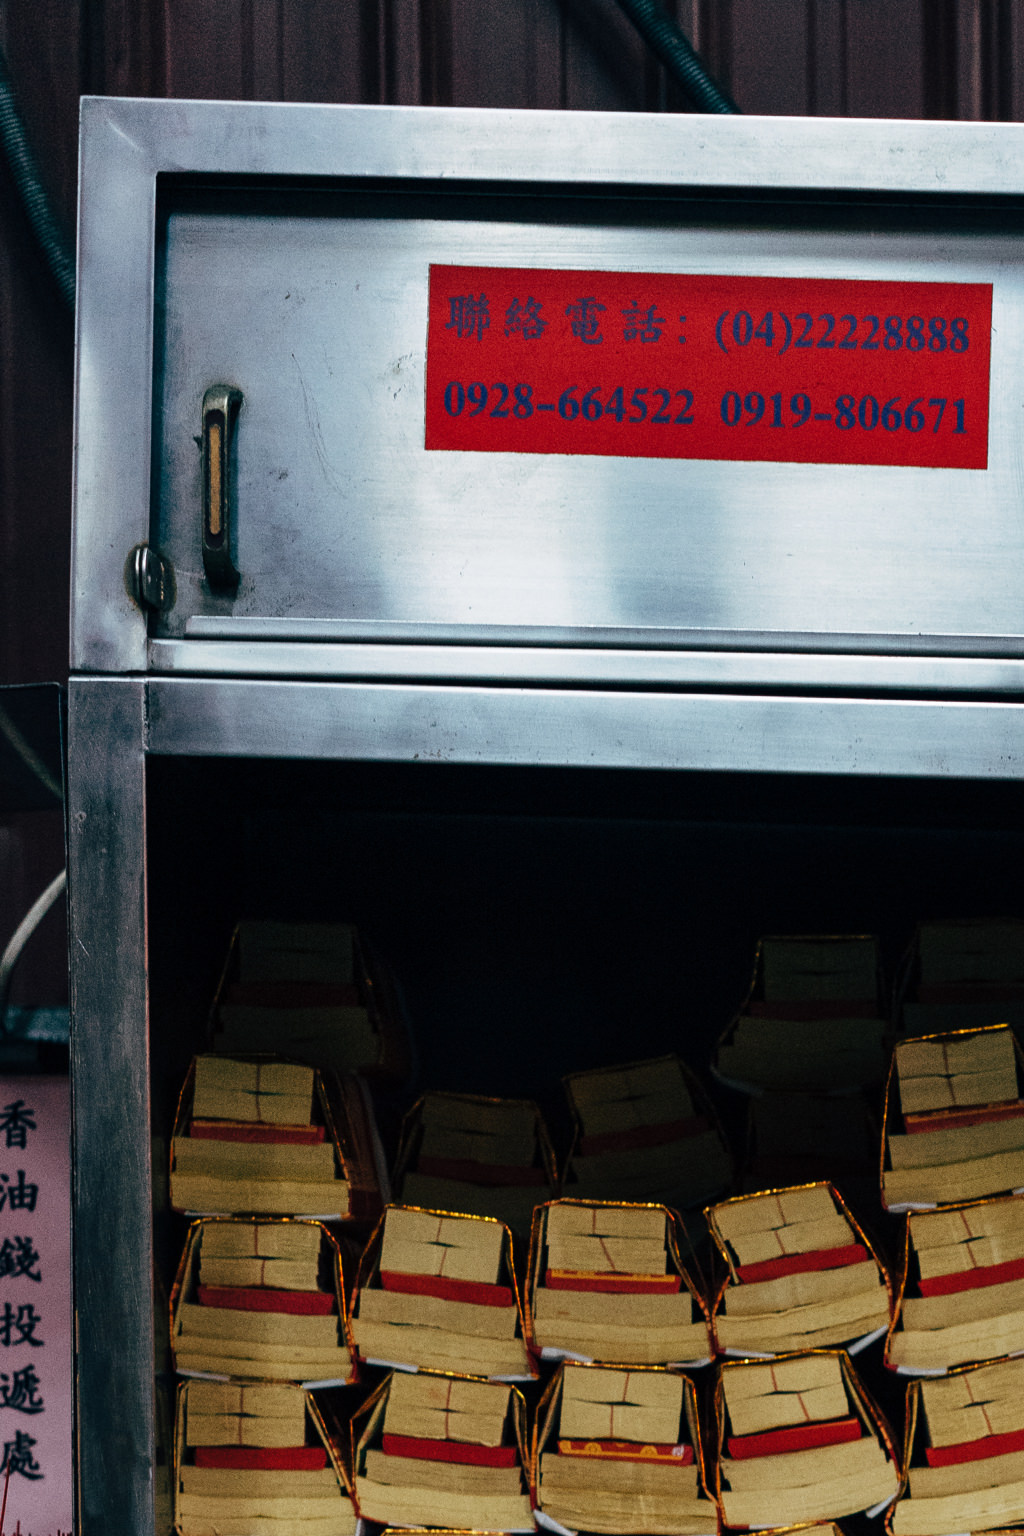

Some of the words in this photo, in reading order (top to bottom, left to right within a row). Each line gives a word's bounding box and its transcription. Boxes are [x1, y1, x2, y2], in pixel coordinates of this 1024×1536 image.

[715, 310, 970, 355] (04)22228888
[443, 380, 694, 425] 0928-664522
[720, 391, 967, 434] 0919-806671
